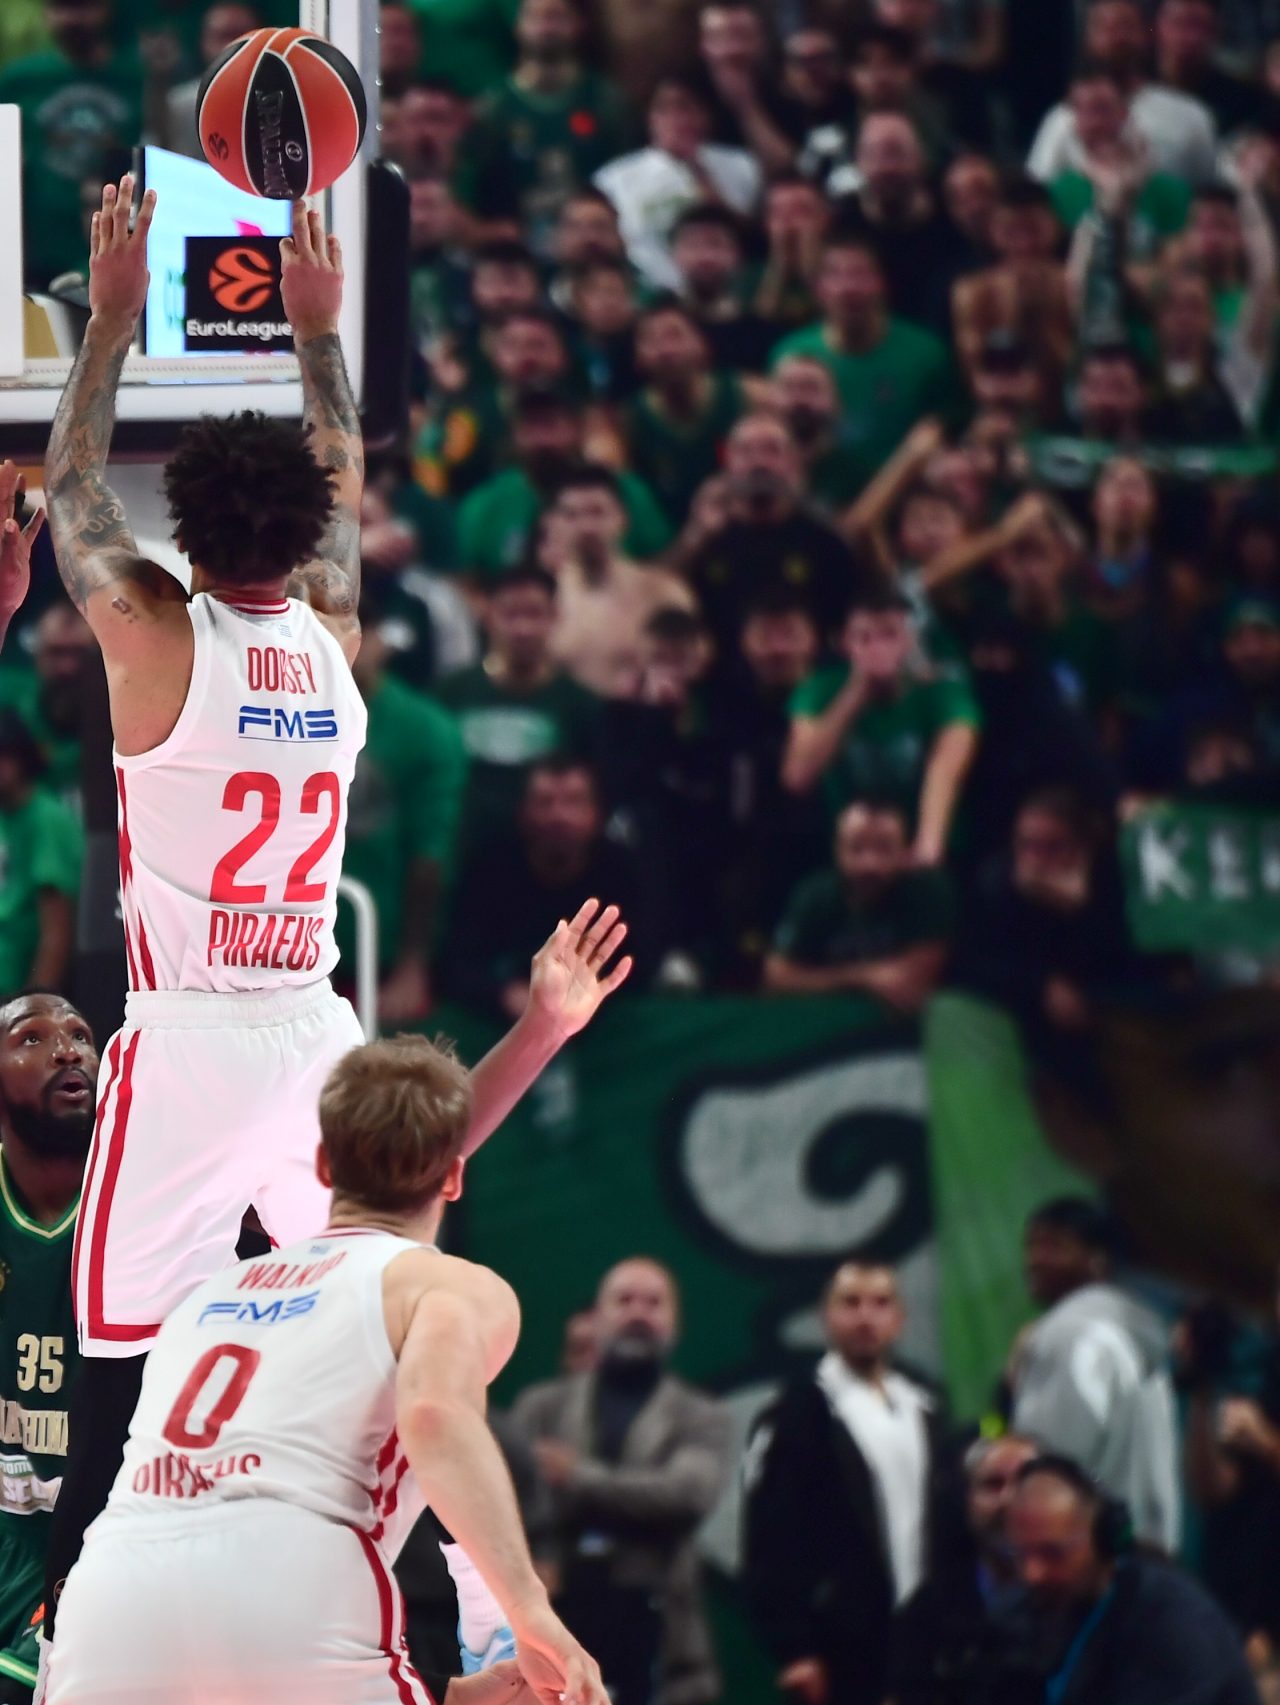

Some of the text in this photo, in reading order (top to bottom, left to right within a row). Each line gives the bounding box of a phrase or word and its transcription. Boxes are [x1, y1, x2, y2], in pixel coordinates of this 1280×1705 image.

[186, 319, 293, 341] EuroLeague
[246, 646, 317, 695] DORSEY
[238, 705, 339, 739] FMS
[209, 771, 341, 904] 22
[208, 909, 325, 972] PIRAEUS
[195, 1289, 321, 1327] FMS
[16, 1333, 65, 1394] 35
[161, 1342, 261, 1450] 0
